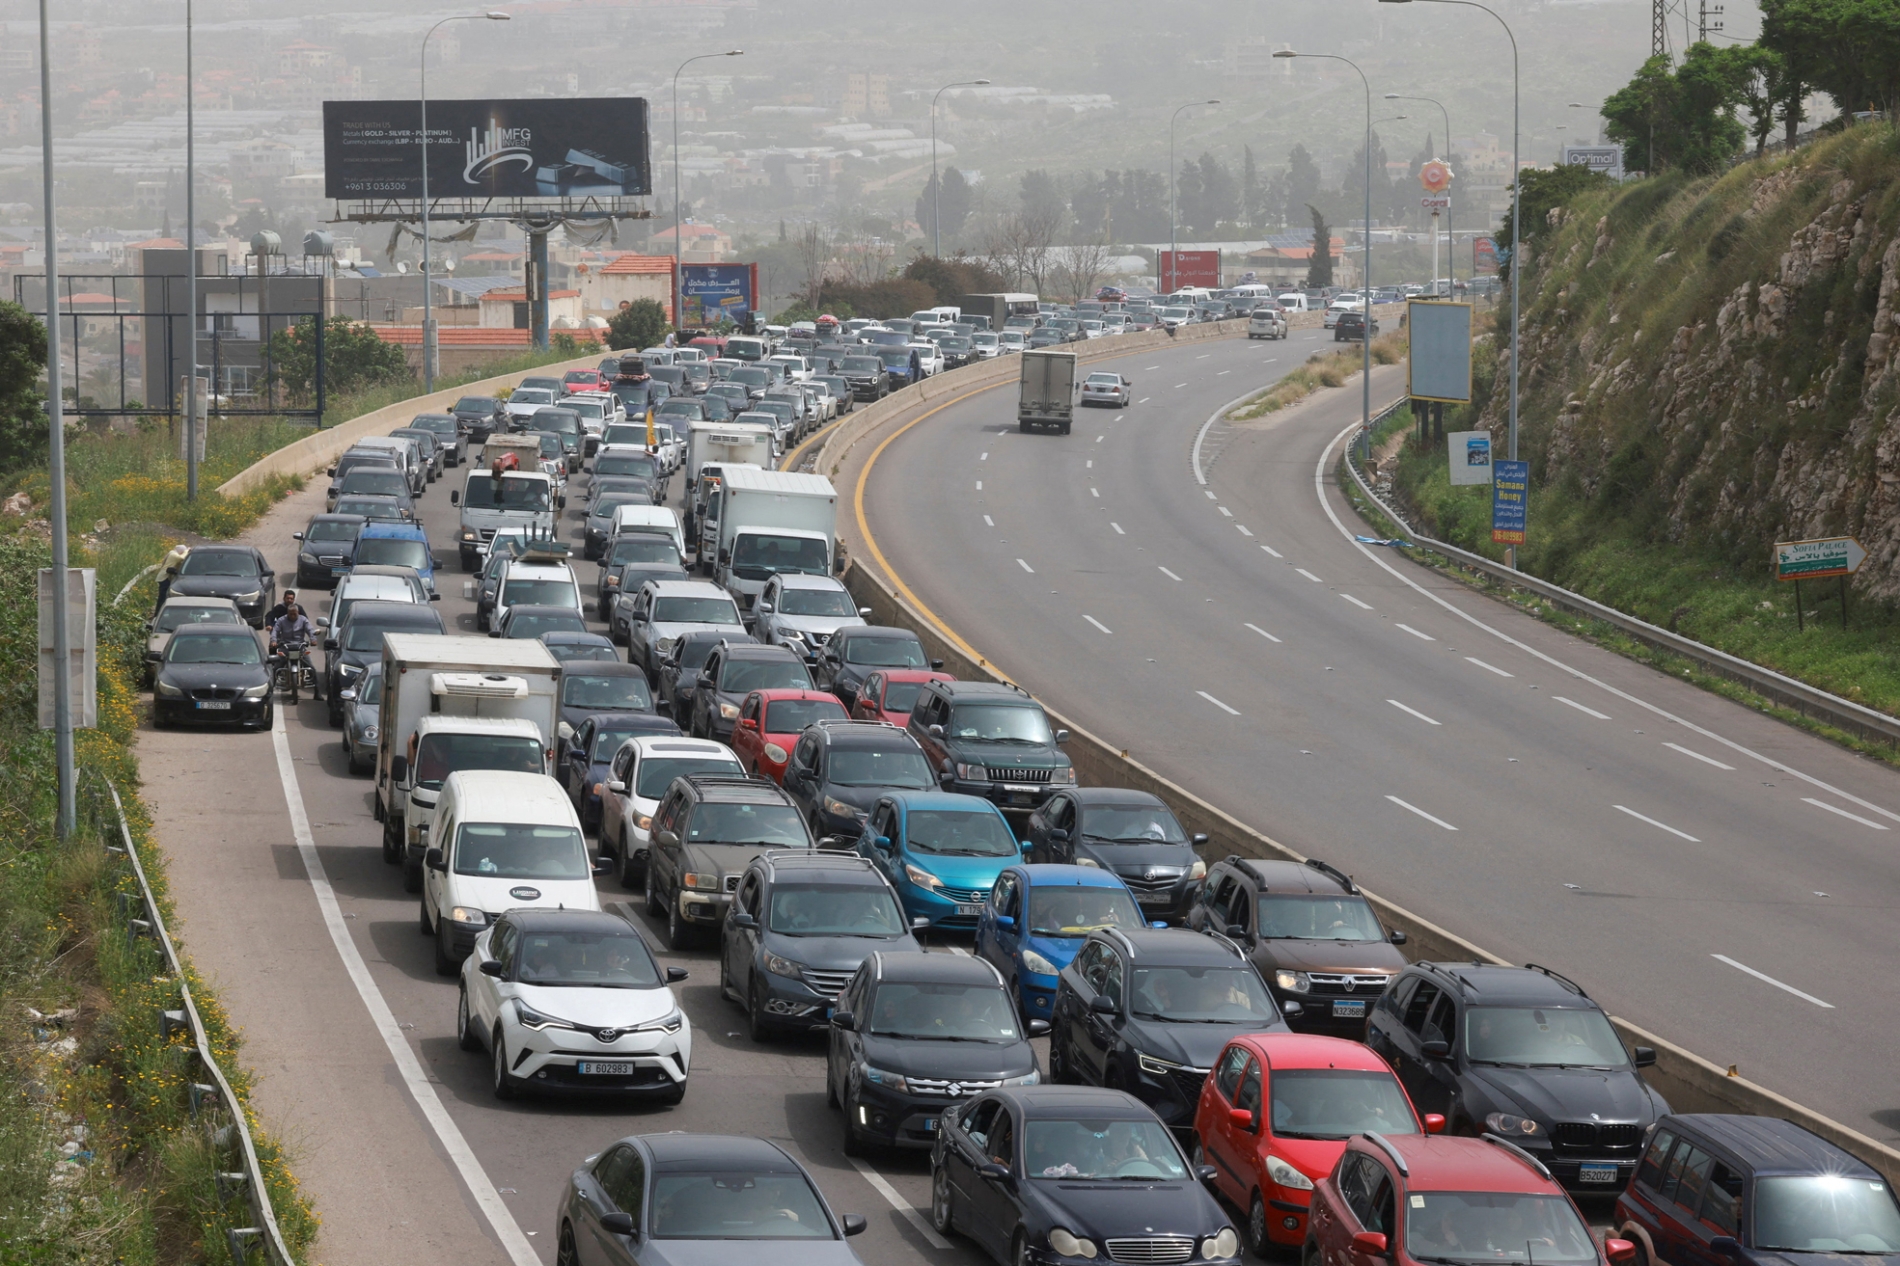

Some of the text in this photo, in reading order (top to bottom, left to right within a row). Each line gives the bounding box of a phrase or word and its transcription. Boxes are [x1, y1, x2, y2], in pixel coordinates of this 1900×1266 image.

[502, 128, 531, 140] MFG
[1571, 153, 1613, 164] Optimal
[1422, 198, 1448, 208] Coral
[1496, 479, 1525, 490] Samana
[1499, 490, 1521, 502] Honey
[1334, 1007, 1364, 1016] N323689
[586, 1064, 628, 1073] B 602983
[1581, 1171, 1616, 1180] B520271
